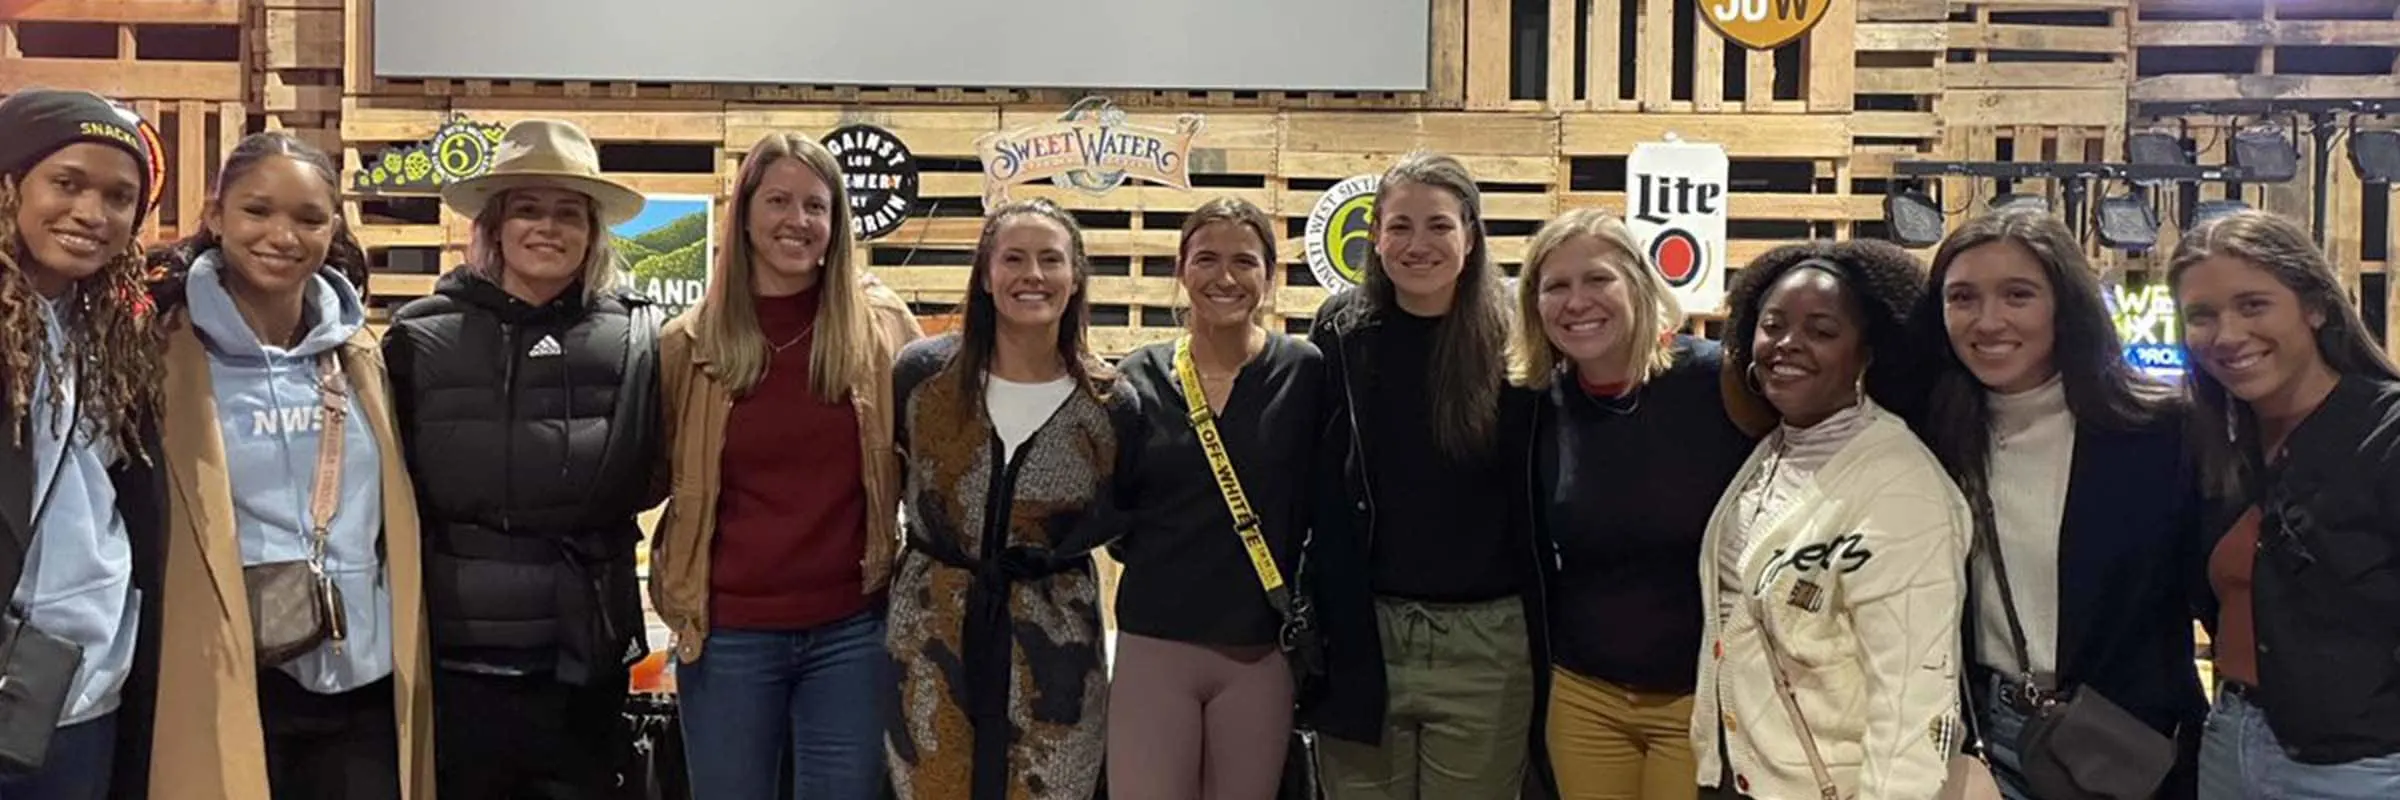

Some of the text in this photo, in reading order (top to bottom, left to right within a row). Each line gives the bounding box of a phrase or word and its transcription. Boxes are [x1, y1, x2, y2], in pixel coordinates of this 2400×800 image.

[827, 131, 905, 167] GAINST
[1634, 173, 1720, 225] Lite
[252, 406, 324, 436] NWS
